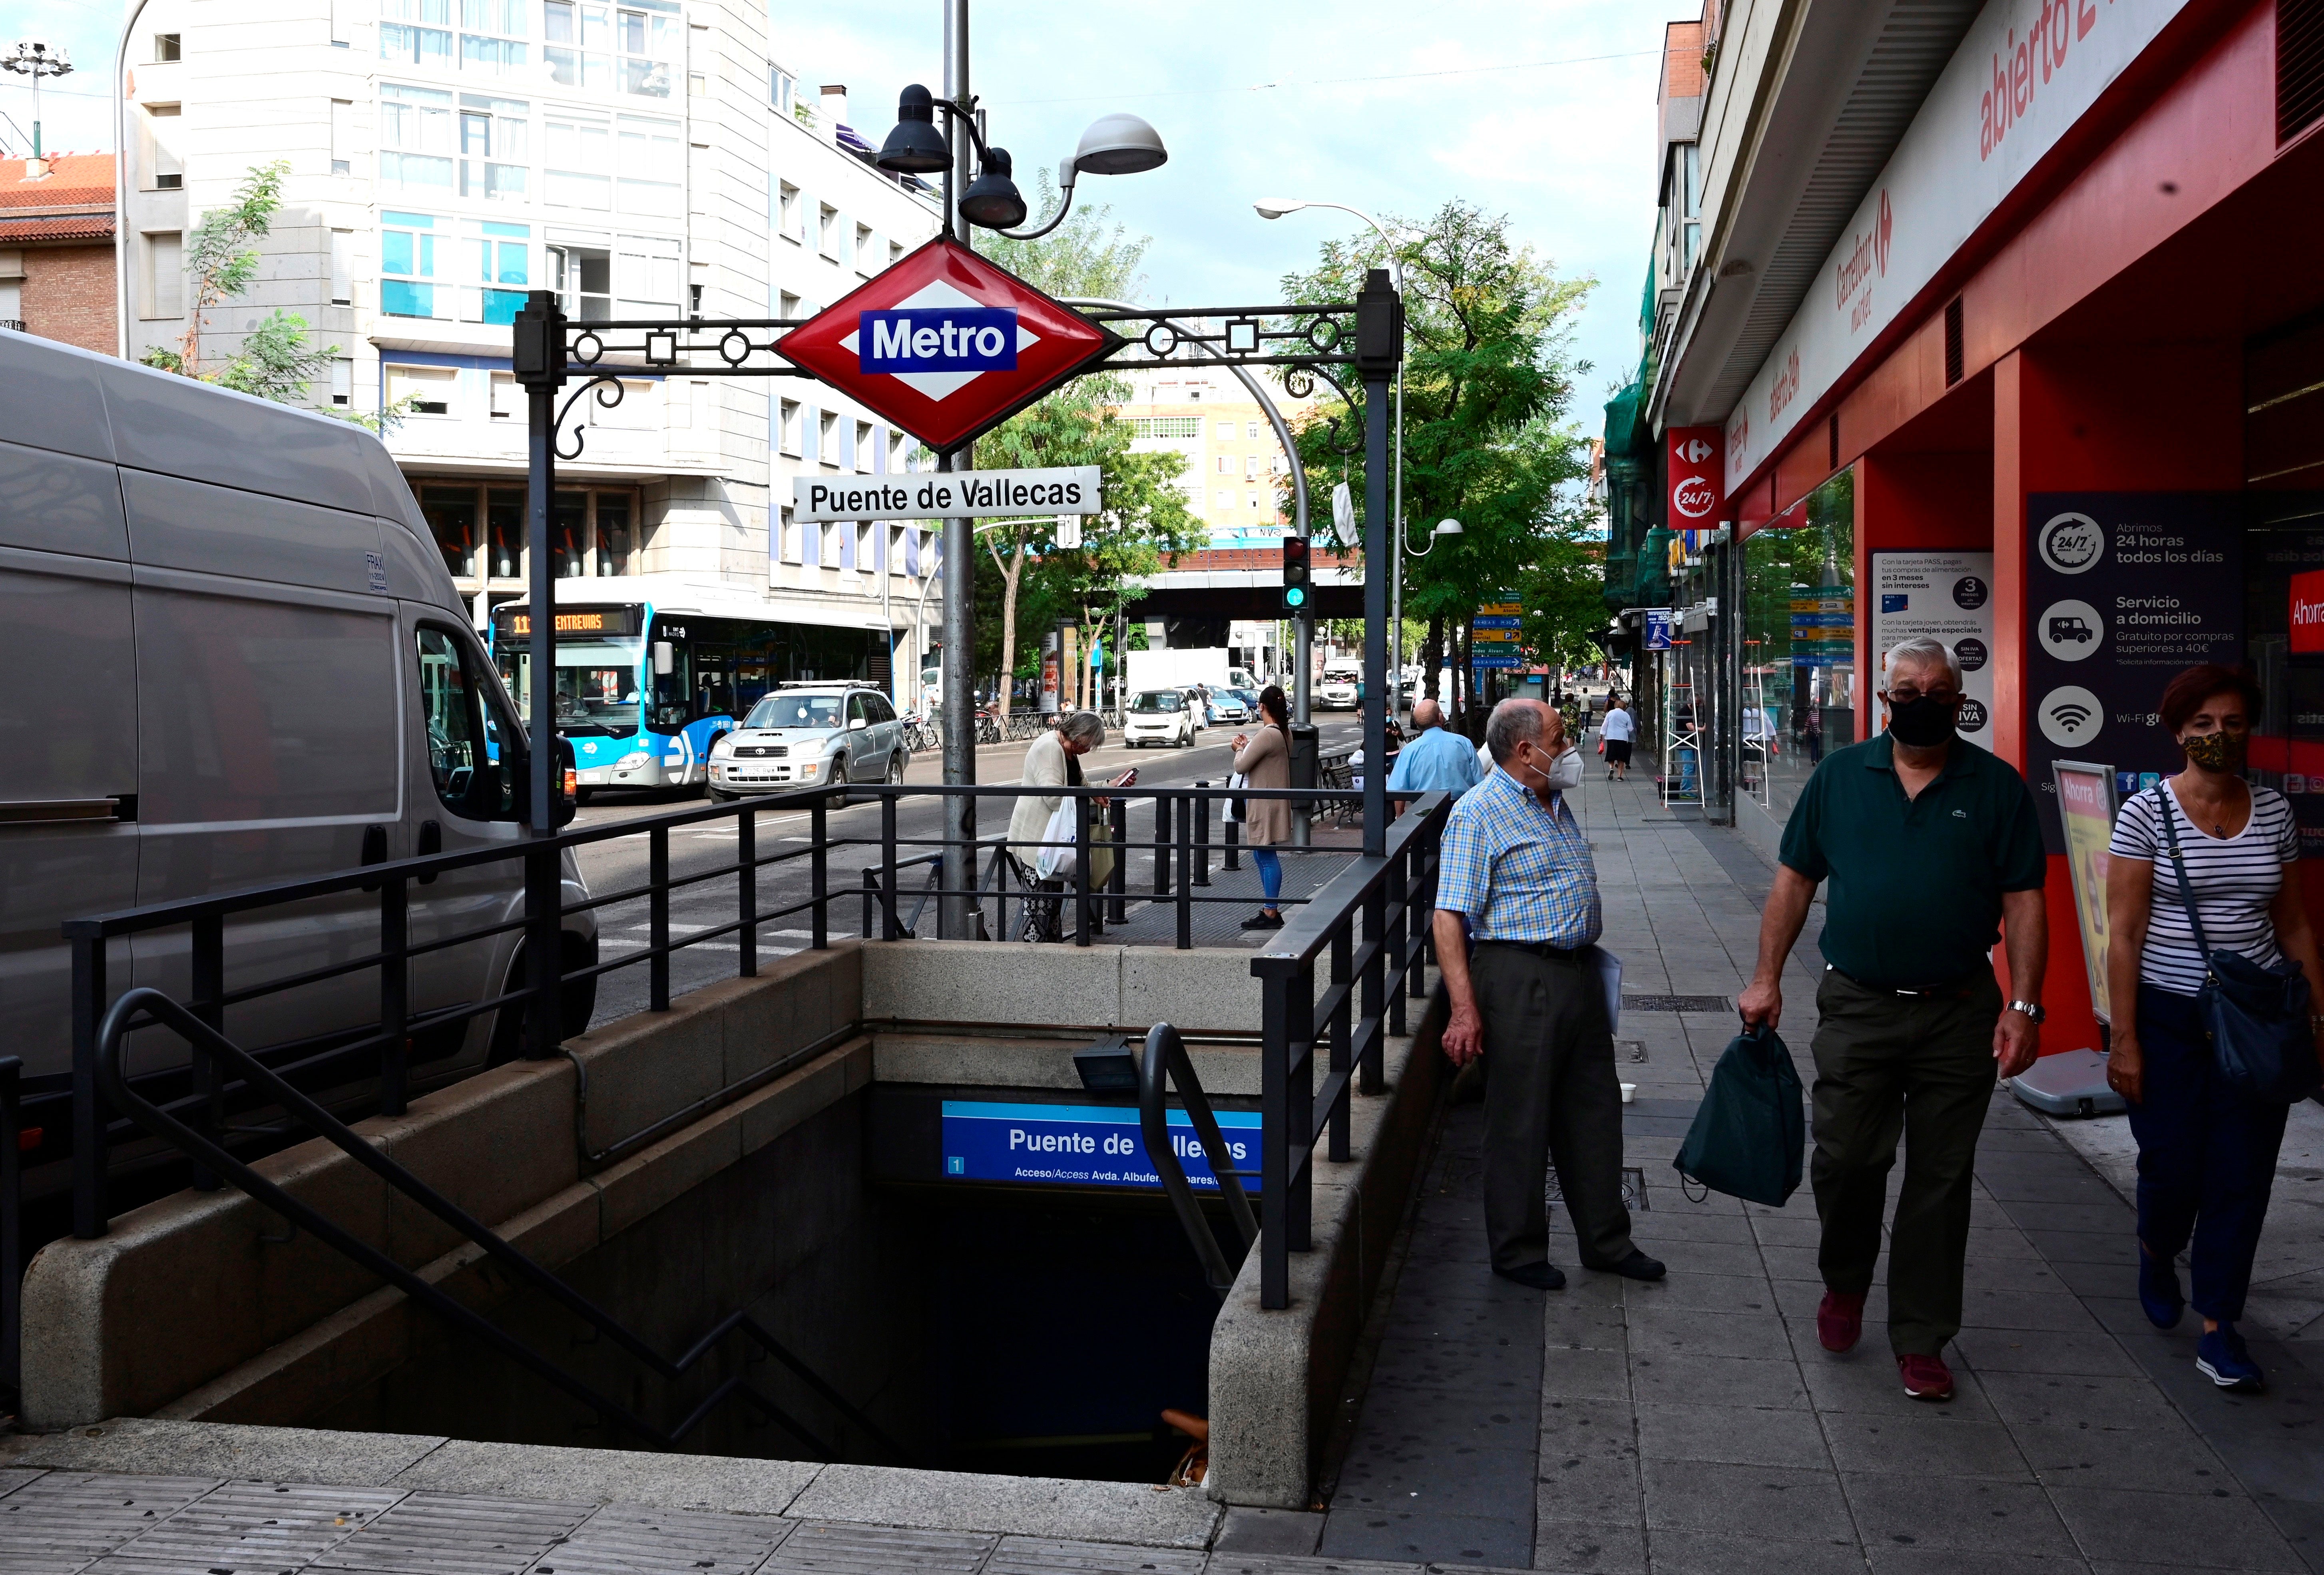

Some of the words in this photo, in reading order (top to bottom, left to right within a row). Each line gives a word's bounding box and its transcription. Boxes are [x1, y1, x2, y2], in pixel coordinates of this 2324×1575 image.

[1981, 0, 2069, 162] abierto
[1837, 231, 1872, 311] Carrefour
[1852, 279, 1872, 335] market
[873, 319, 1005, 359] Metro
[1770, 369, 1787, 424] abierto
[811, 484, 908, 512] Puente
[917, 481, 952, 510] de
[960, 478, 1082, 508] Vallecas
[1681, 491, 1711, 505] 24/7
[2116, 523, 2163, 532] Abrimos
[2057, 536, 2087, 548] 24/7
[2117, 535, 2136, 546] 24
[2140, 534, 2184, 546] horas
[366, 554, 384, 570] FRAX
[2116, 550, 2162, 563] todos
[2165, 550, 2187, 562] los
[2191, 550, 2223, 562] días
[369, 572, 384, 581] 11-2024
[1965, 578, 1976, 592] 3
[2116, 595, 2180, 608] Servicio
[2116, 615, 2125, 624] a
[2129, 612, 2201, 624] domicilio
[2294, 598, 2324, 625] Ahorra
[514, 616, 531, 633] 11
[555, 614, 602, 630] ENTREVIAS
[2116, 631, 2161, 641] Gratuito
[2164, 634, 2183, 642] por
[2185, 634, 2234, 642] compras
[2116, 643, 2174, 654] superiores
[2185, 644, 2209, 652] 40€
[2117, 714, 2144, 723] Wi-Fi
[2065, 778, 2093, 803] Ahorra
[1010, 1128, 1095, 1154] Puente
[1103, 1133, 1134, 1155] de
[1174, 1135, 1247, 1160] lles
[953, 1158, 960, 1172] 1
[1015, 1167, 1089, 1180] Acceso/Access
[1092, 1170, 1120, 1181] Avda.
[1123, 1171, 1162, 1182] Albufer
